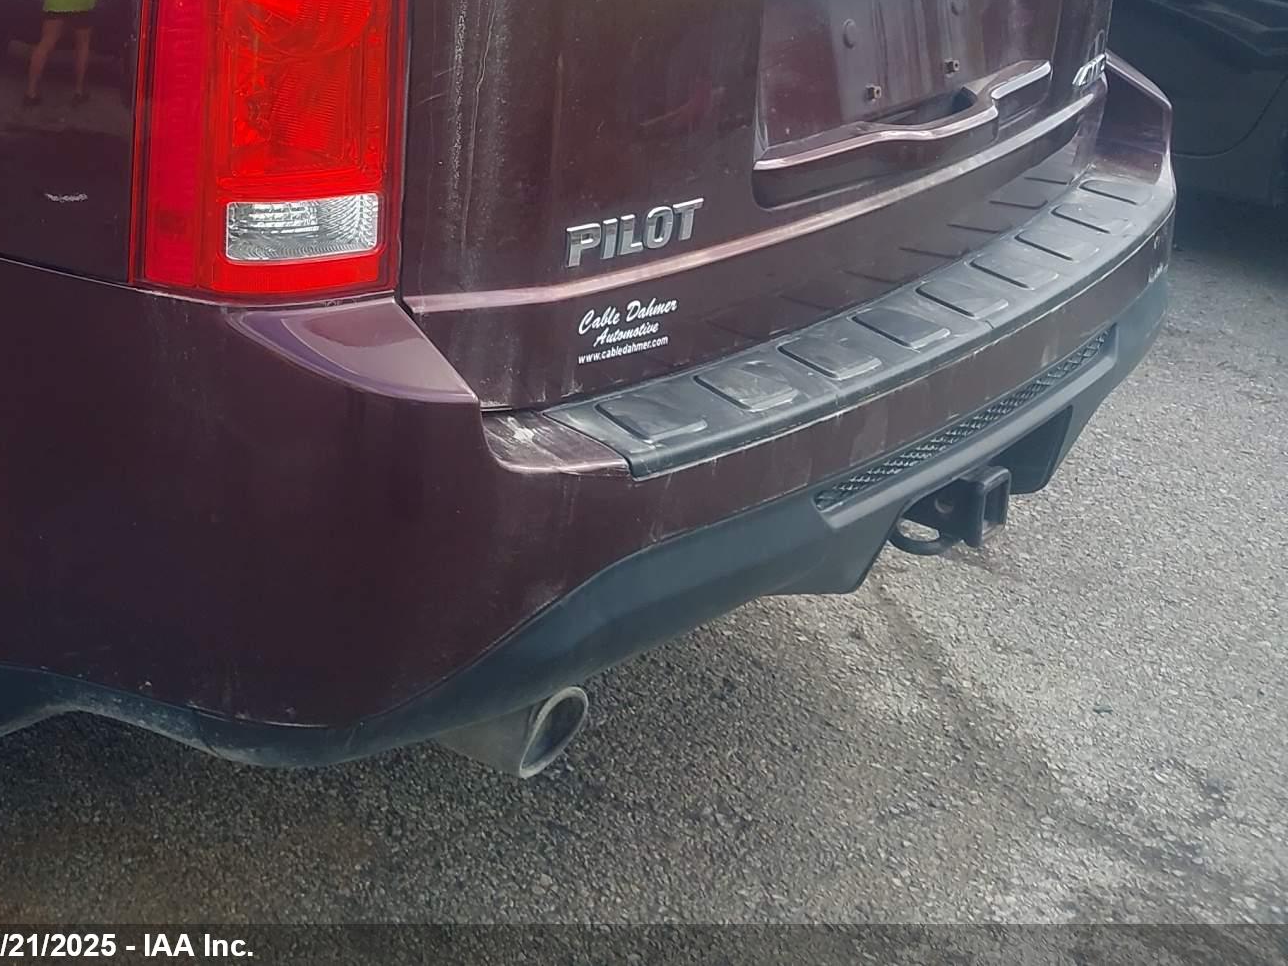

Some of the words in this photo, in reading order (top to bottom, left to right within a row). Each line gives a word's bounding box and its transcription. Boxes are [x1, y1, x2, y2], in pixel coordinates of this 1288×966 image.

[566, 197, 705, 268] PILOT
[578, 306, 621, 335] Cable
[626, 297, 679, 323] Dahmer
[577, 335, 669, 365] www.cabledahmer.com
[593, 321, 660, 348] Automotive
